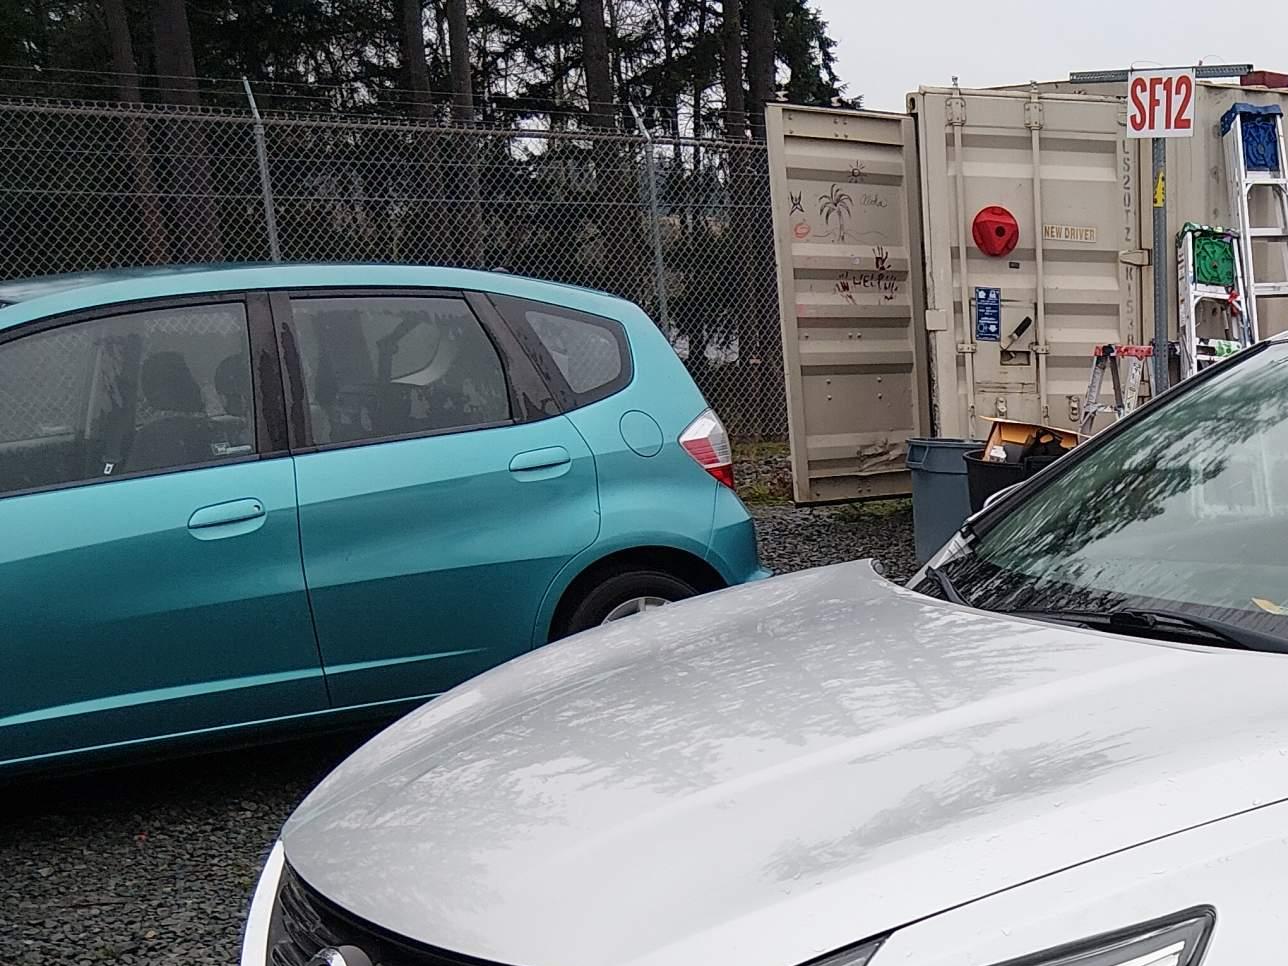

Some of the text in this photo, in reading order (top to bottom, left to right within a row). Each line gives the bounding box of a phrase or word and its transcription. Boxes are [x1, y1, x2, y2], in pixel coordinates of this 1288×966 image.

[1130, 75, 1192, 131] SF12
[1043, 225, 1096, 241] NEW DRIVER
